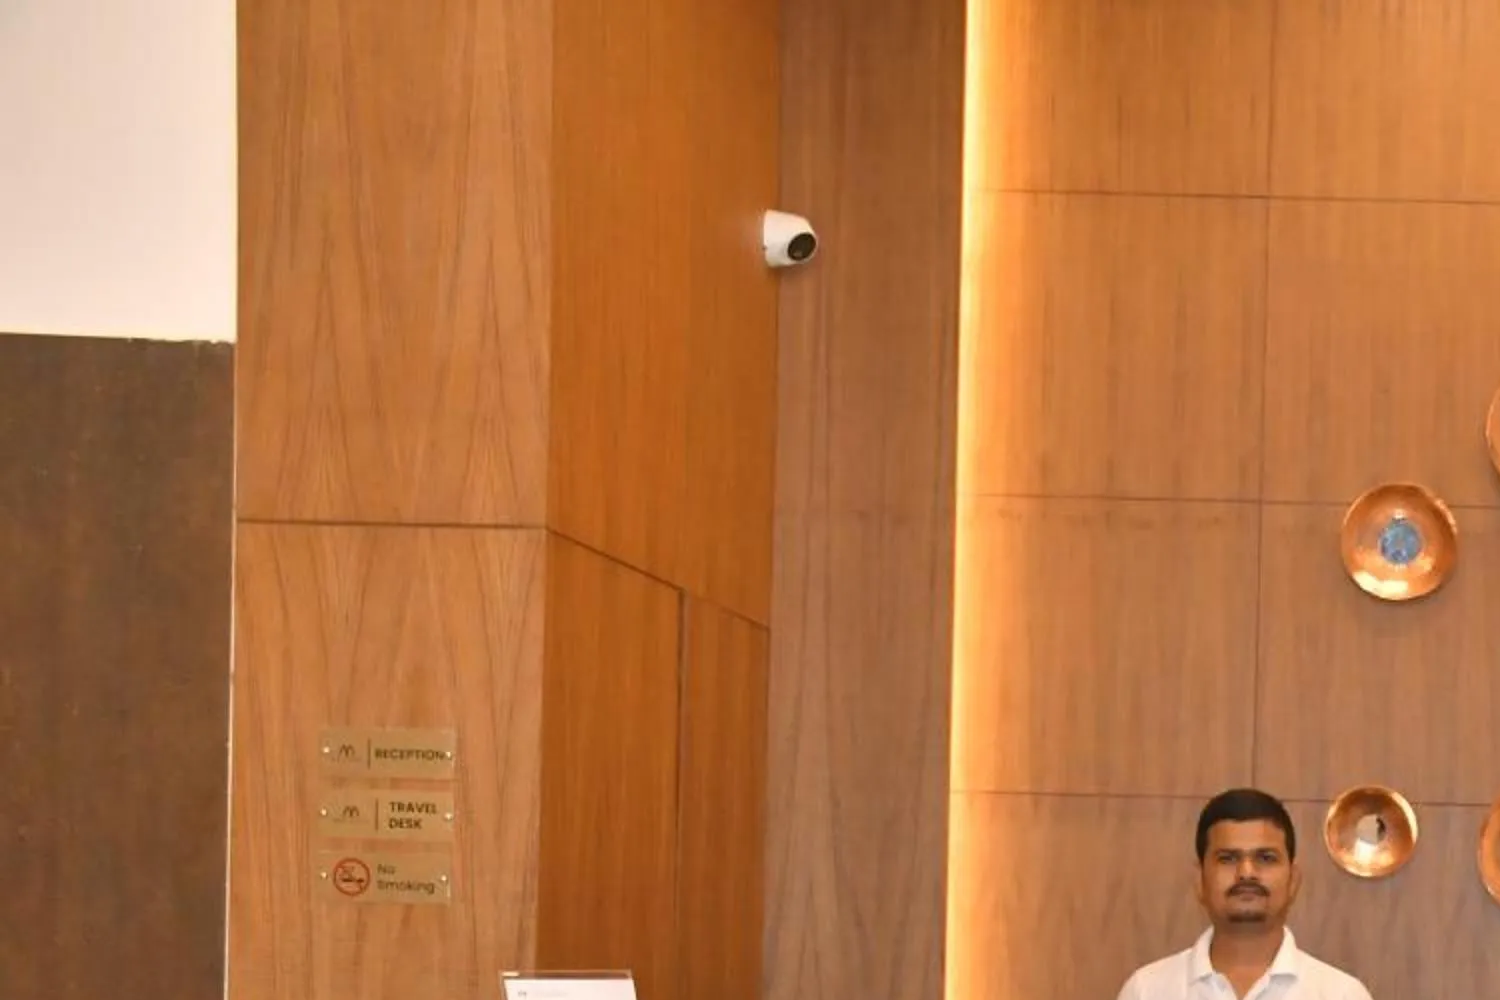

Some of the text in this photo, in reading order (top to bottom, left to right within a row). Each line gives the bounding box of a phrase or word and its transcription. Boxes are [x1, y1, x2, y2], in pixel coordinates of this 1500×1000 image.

[374, 748, 446, 761] RECEPTION
[388, 801, 437, 814] TRAVEL
[388, 817, 422, 830] DESK
[376, 863, 396, 875] No
[376, 879, 435, 895] Smoking
